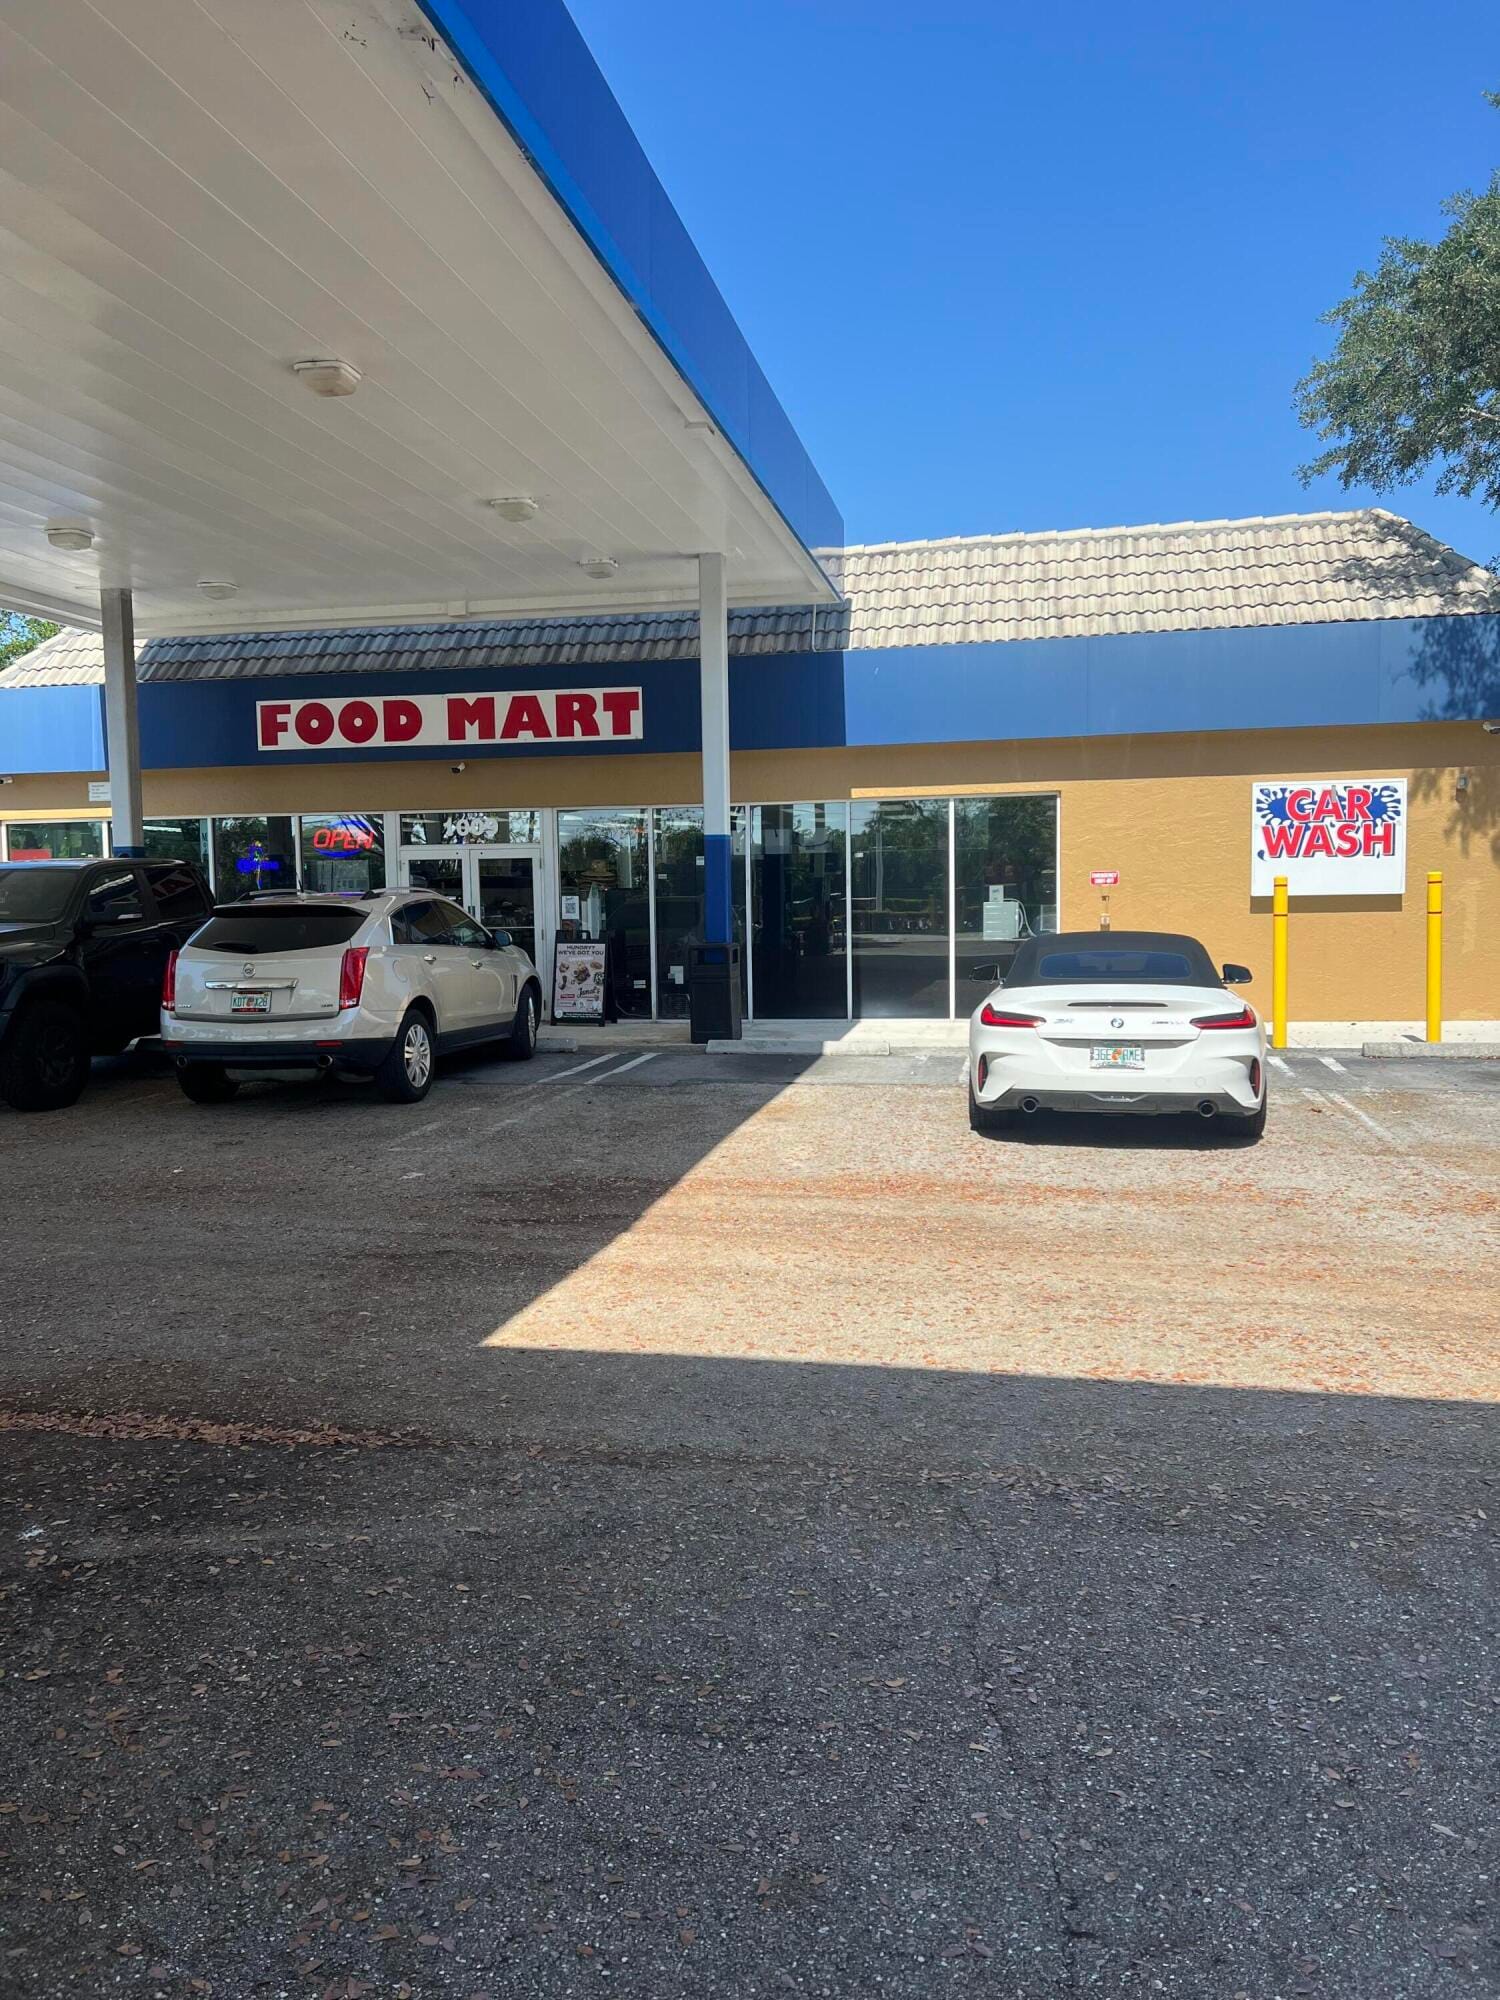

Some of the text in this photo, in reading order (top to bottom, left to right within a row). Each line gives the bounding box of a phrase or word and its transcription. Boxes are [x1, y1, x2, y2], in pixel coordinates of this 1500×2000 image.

[259, 691, 640, 746] FOOD MART
[1285, 787, 1374, 823] CAR
[312, 828, 375, 849] OPEN
[1261, 822, 1396, 859] WASH
